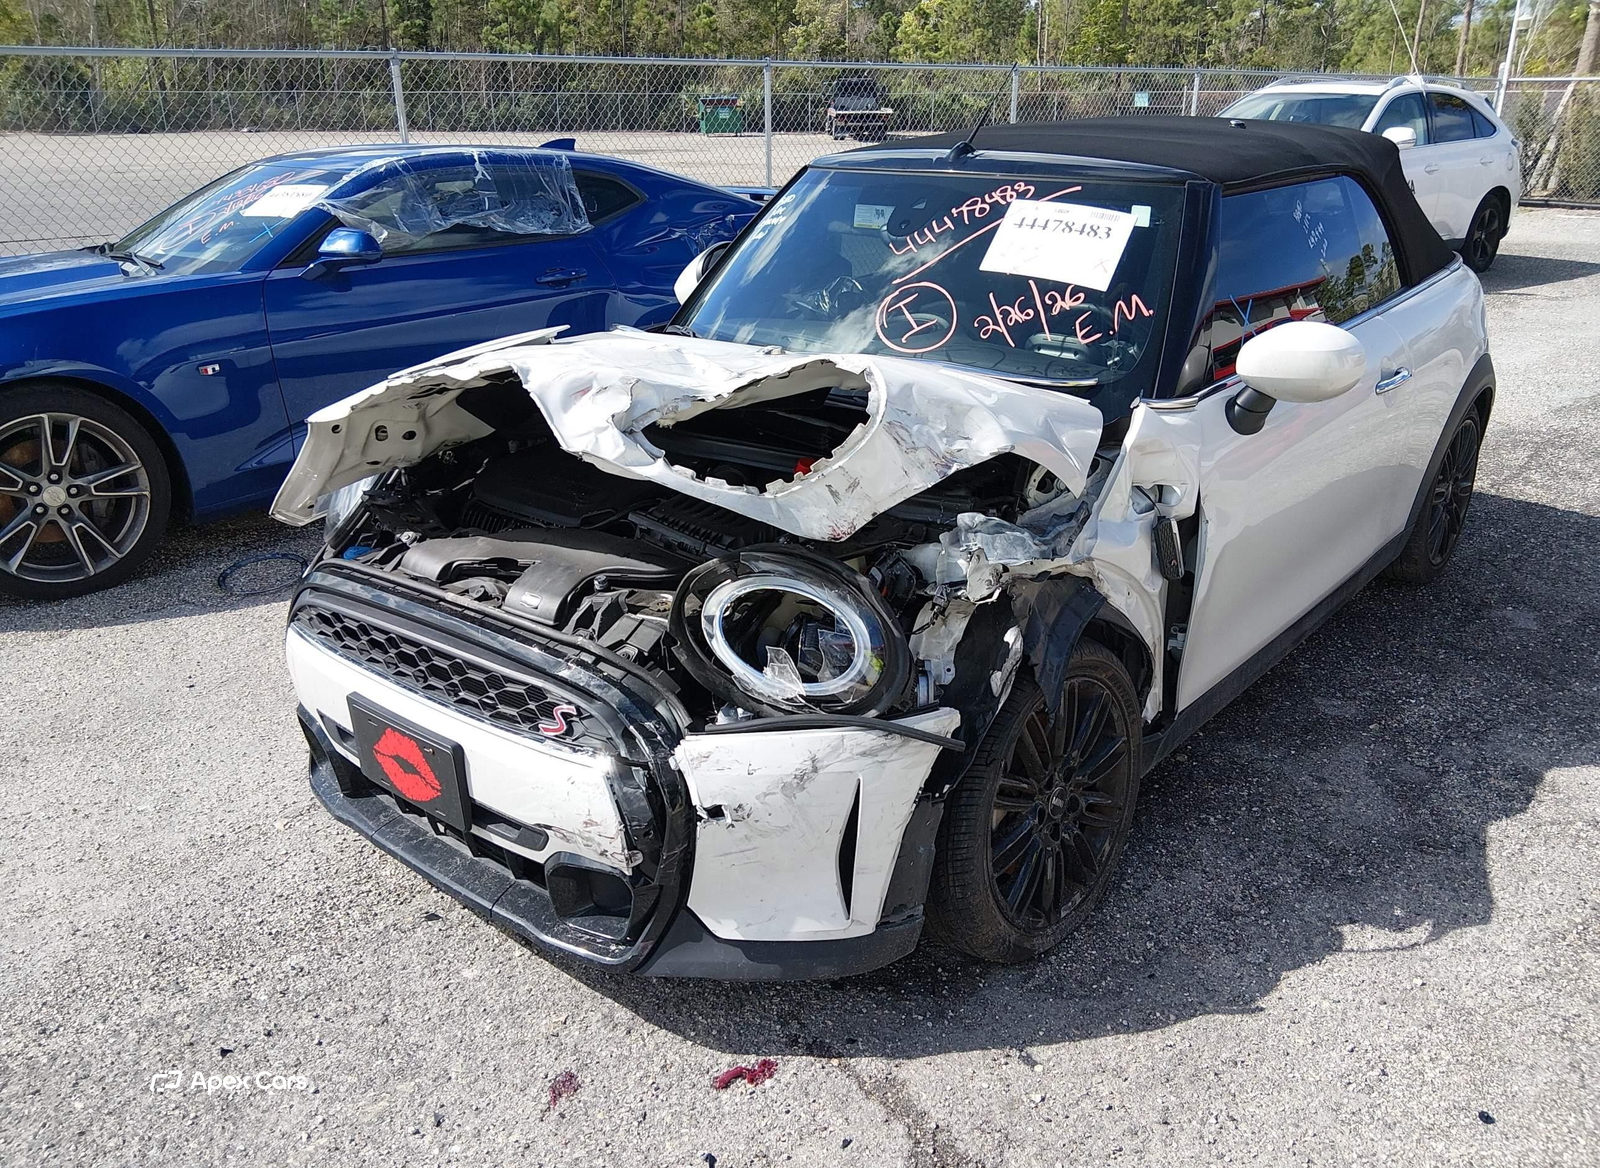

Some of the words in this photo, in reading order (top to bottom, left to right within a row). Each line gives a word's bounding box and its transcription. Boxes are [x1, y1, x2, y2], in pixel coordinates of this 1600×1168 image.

[889, 181, 1035, 255] 44478483
[1013, 216, 1113, 240] 44478483
[538, 704, 577, 736] S
